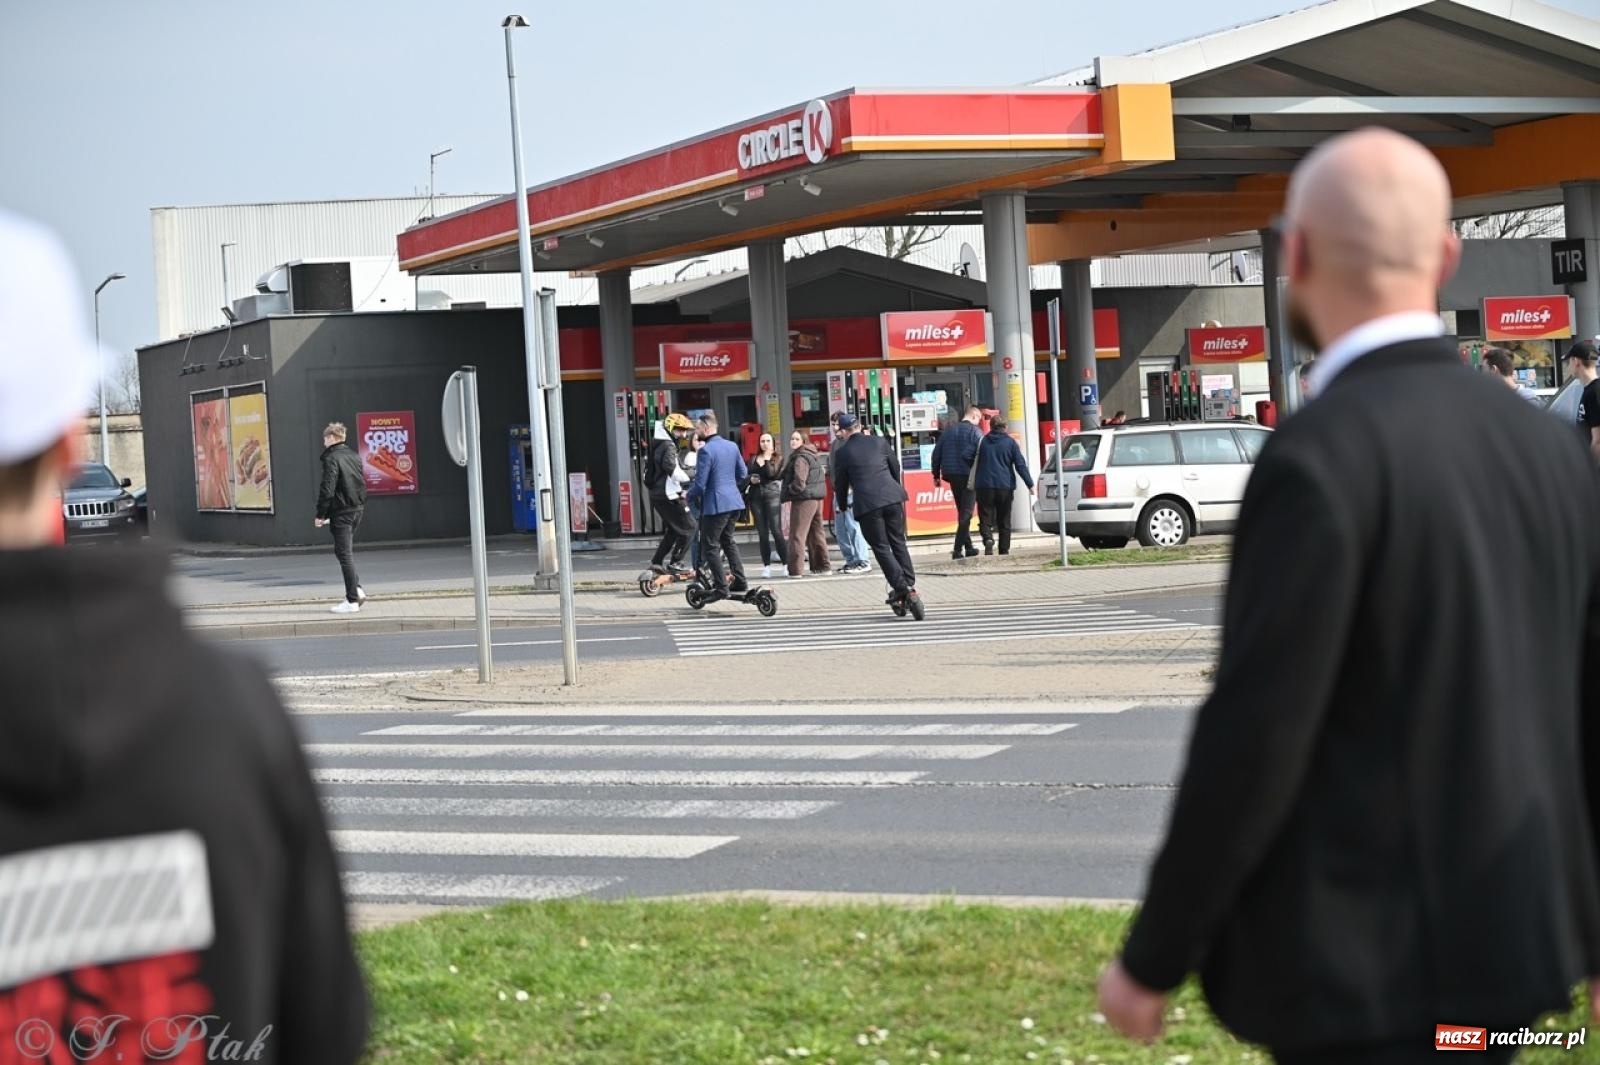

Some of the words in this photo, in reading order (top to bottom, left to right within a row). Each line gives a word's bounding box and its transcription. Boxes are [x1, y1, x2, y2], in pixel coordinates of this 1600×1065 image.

[738, 119, 804, 169] CIRCLE
[1555, 249, 1584, 273] TIR
[1003, 357, 1013, 370] 8
[1080, 385, 1092, 402] P
[364, 430, 409, 445] CORN
